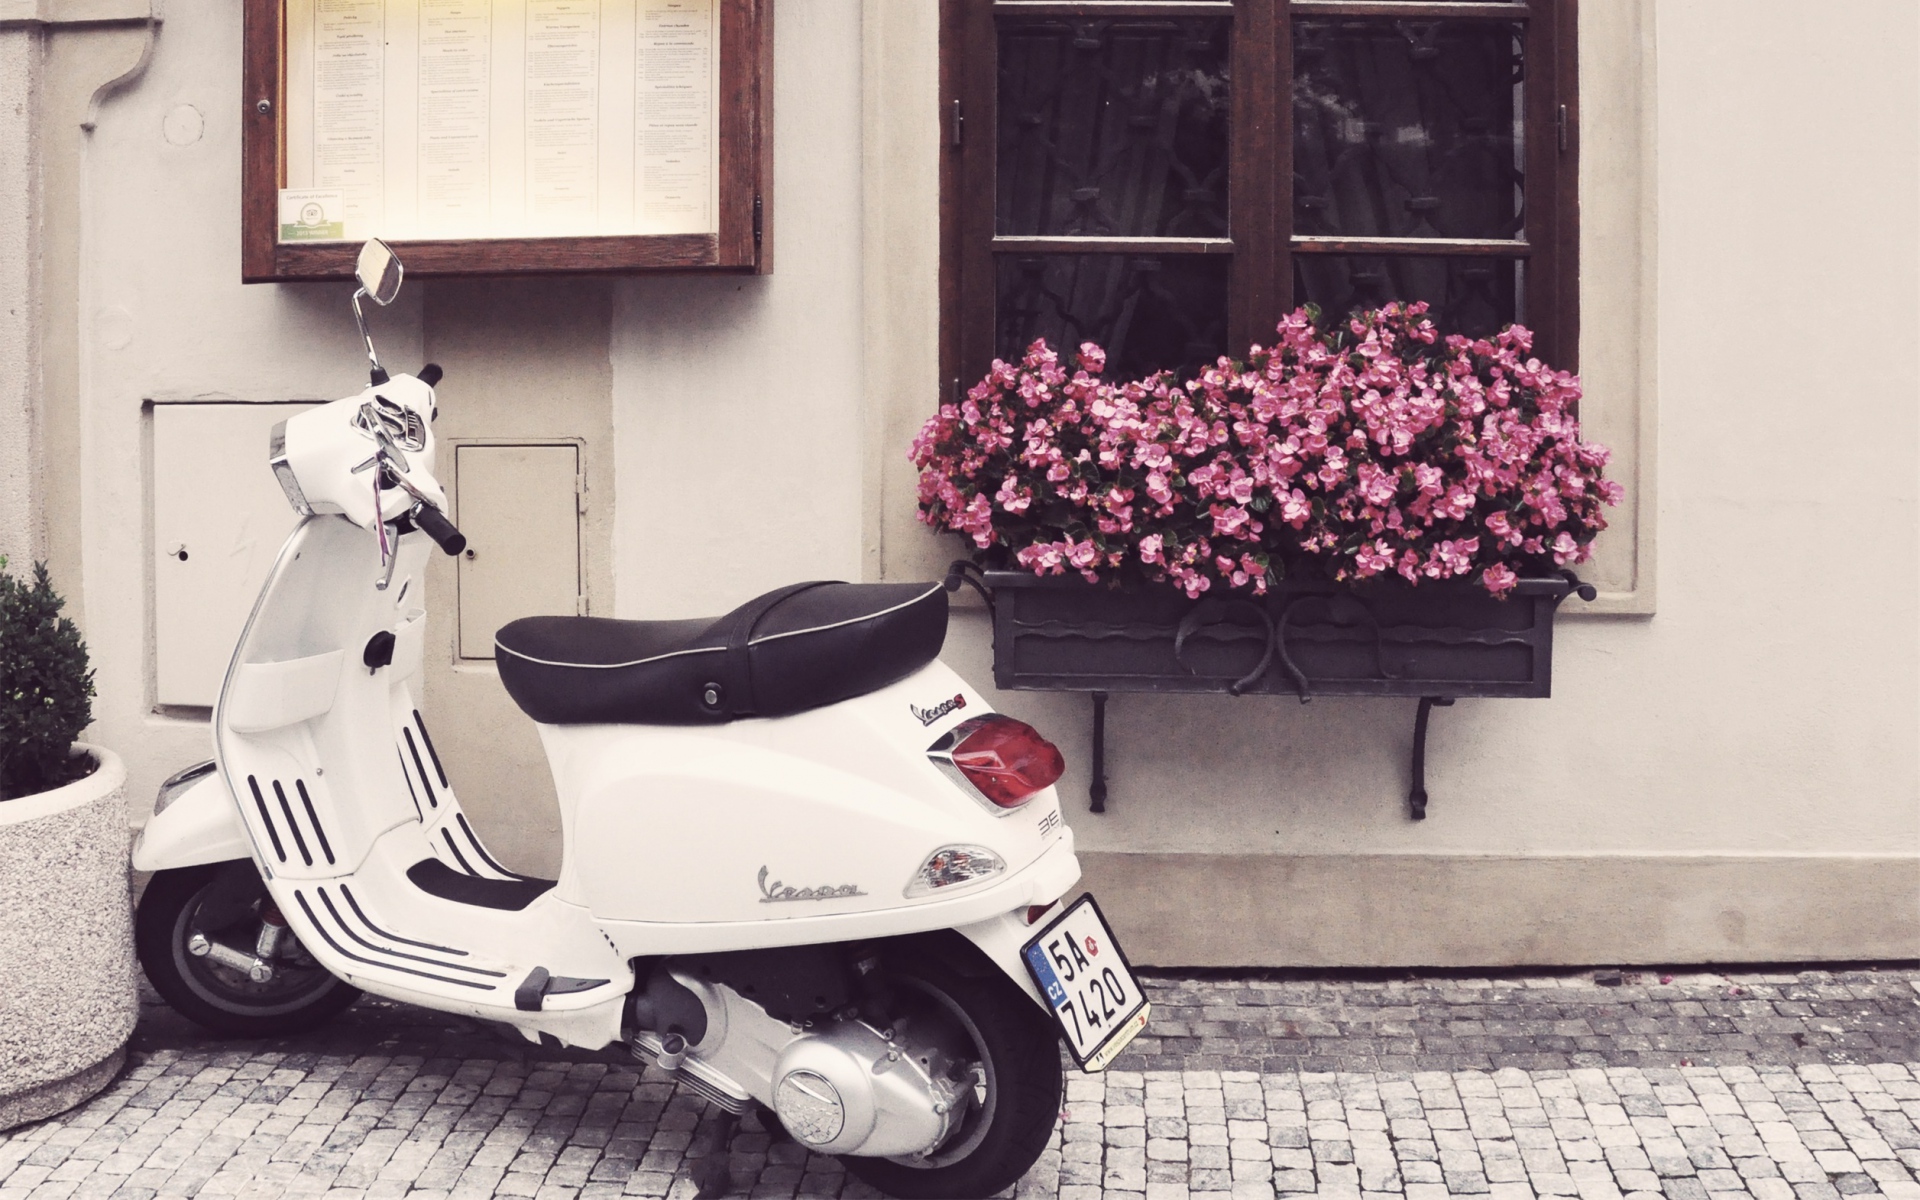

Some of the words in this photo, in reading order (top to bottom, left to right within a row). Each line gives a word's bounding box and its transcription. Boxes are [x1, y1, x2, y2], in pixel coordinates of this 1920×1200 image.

[757, 865, 868, 903] Vespa
[1048, 931, 1090, 982] 5A
[1047, 981, 1063, 1000] CZ
[1061, 967, 1126, 1047] 7420
